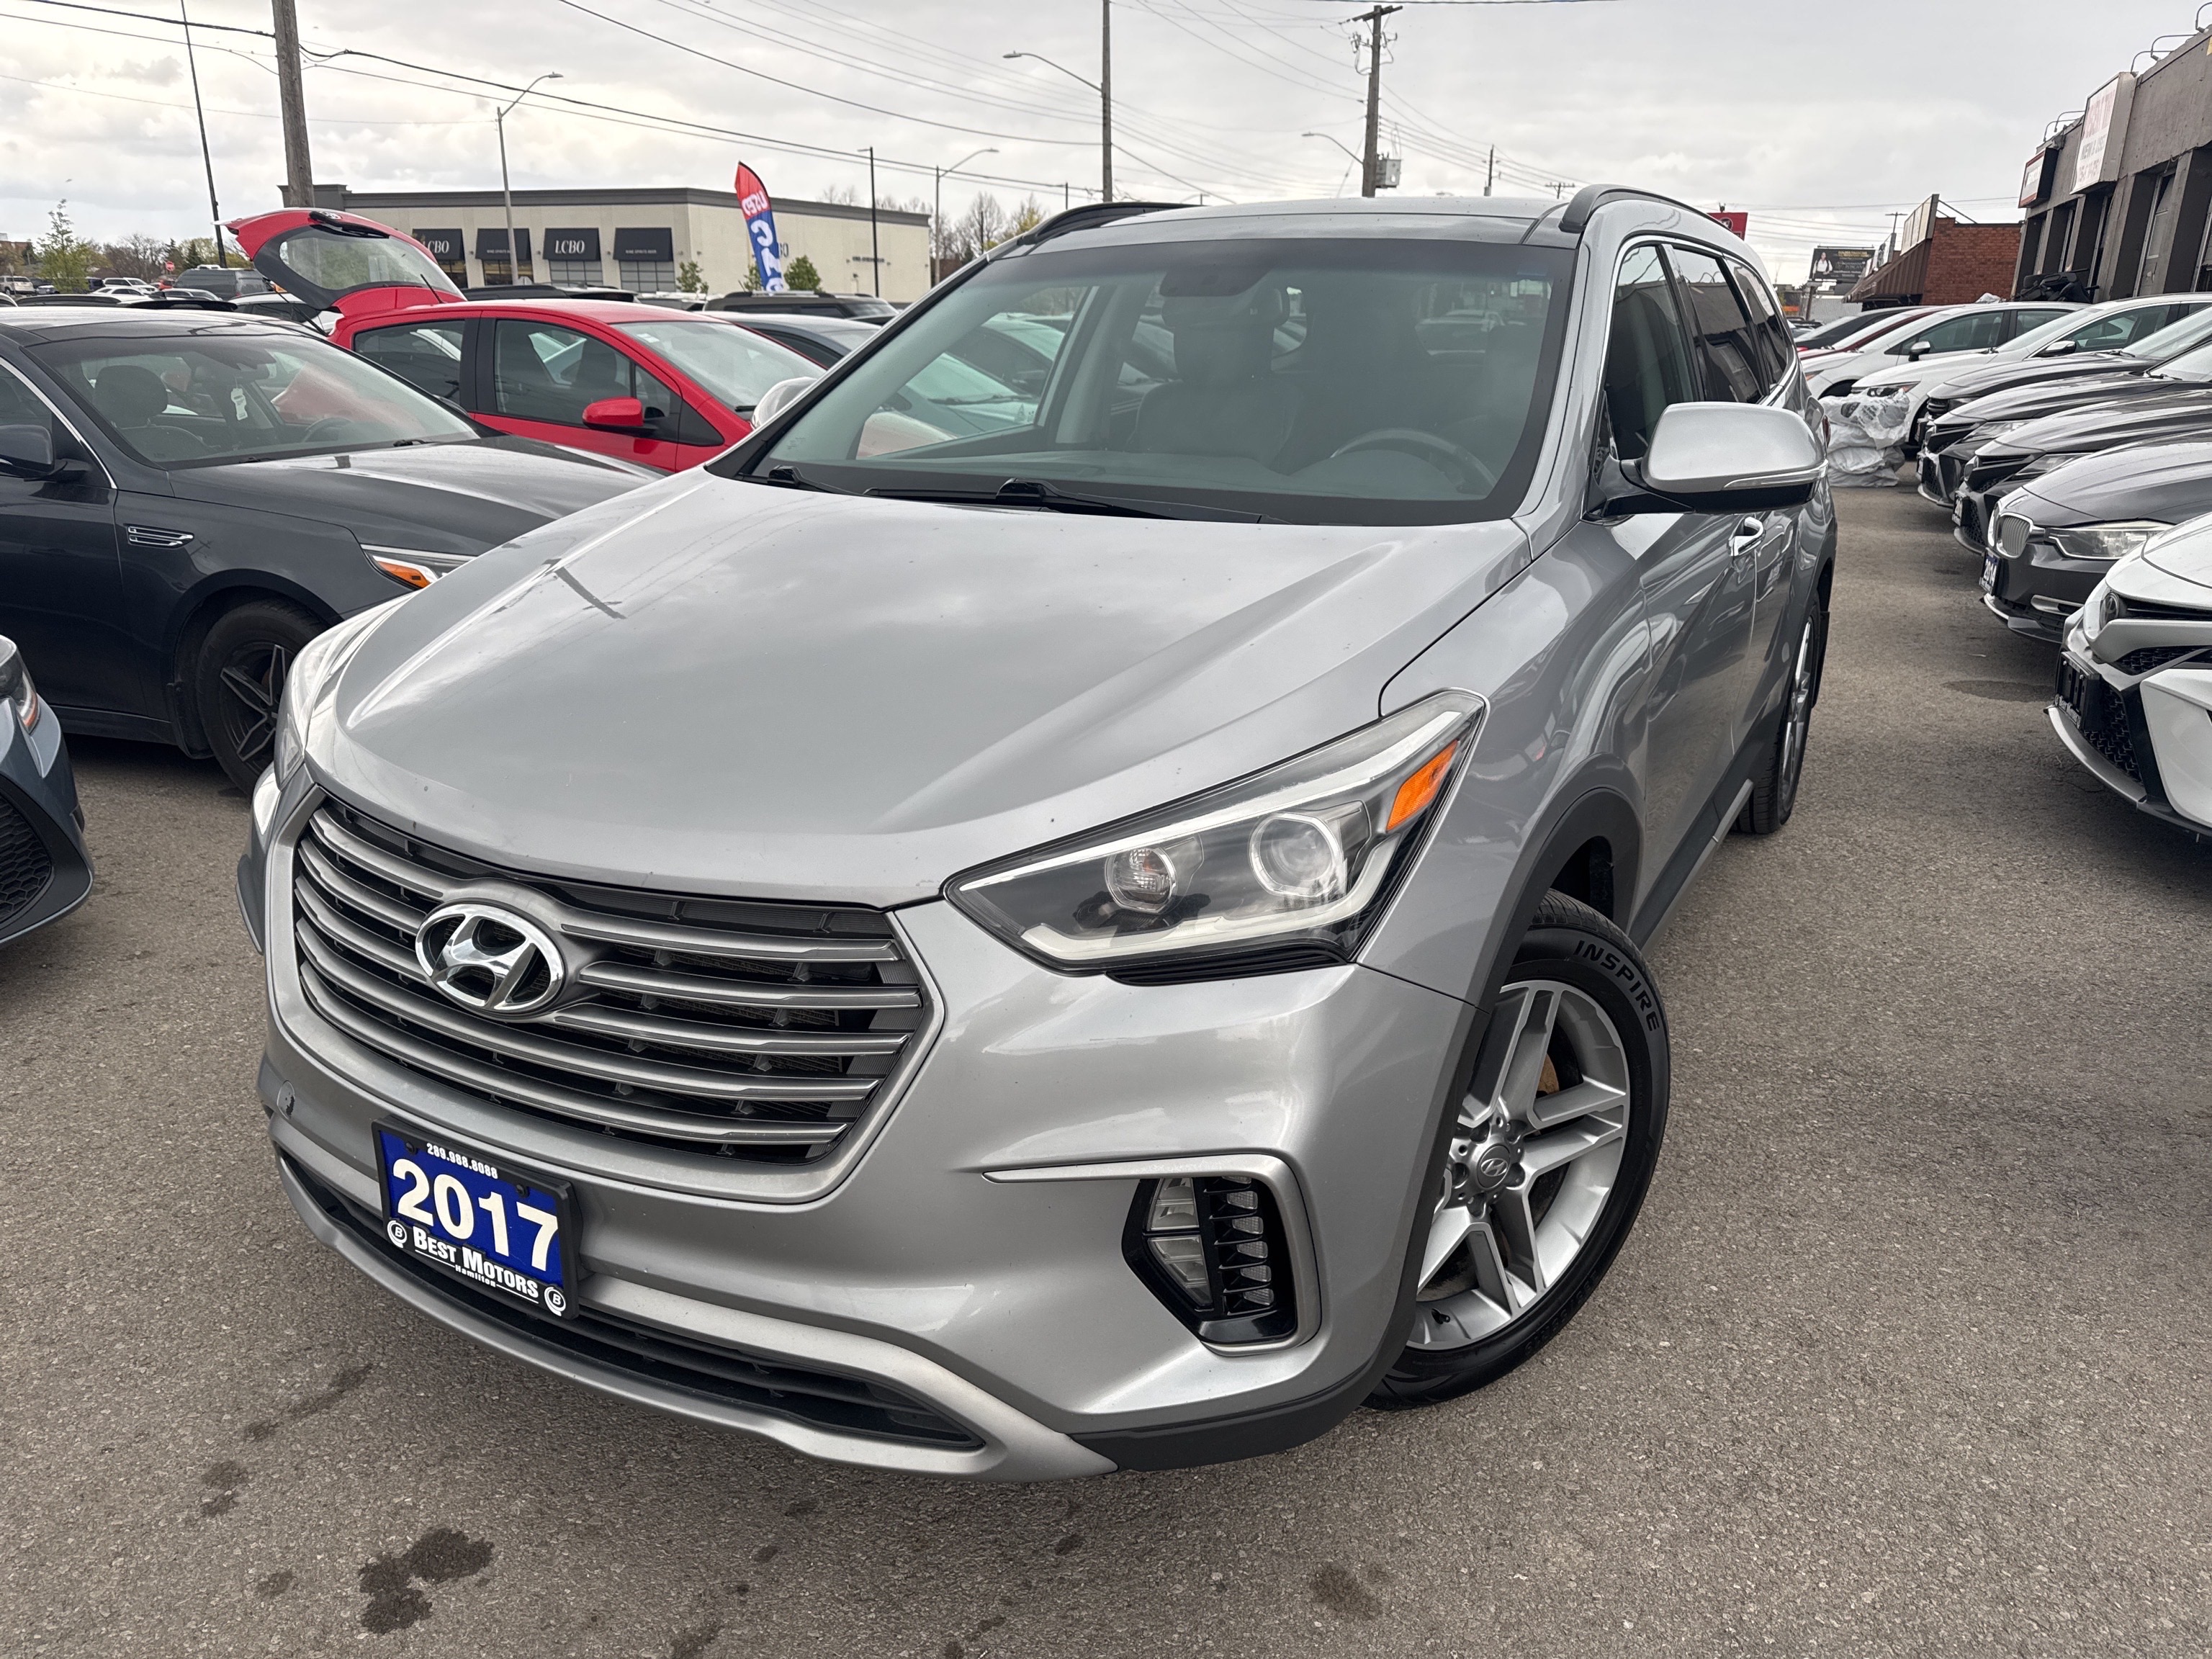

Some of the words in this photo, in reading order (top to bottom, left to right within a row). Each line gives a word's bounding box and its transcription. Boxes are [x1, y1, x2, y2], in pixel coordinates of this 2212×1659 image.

[555, 240, 585, 254] LCBO
[1573, 940, 1660, 1031] INSPIRE
[426, 1143, 498, 1179] 289.988.8088
[392, 1158, 559, 1272] 2017
[455, 1264, 496, 1287] Hamilton
